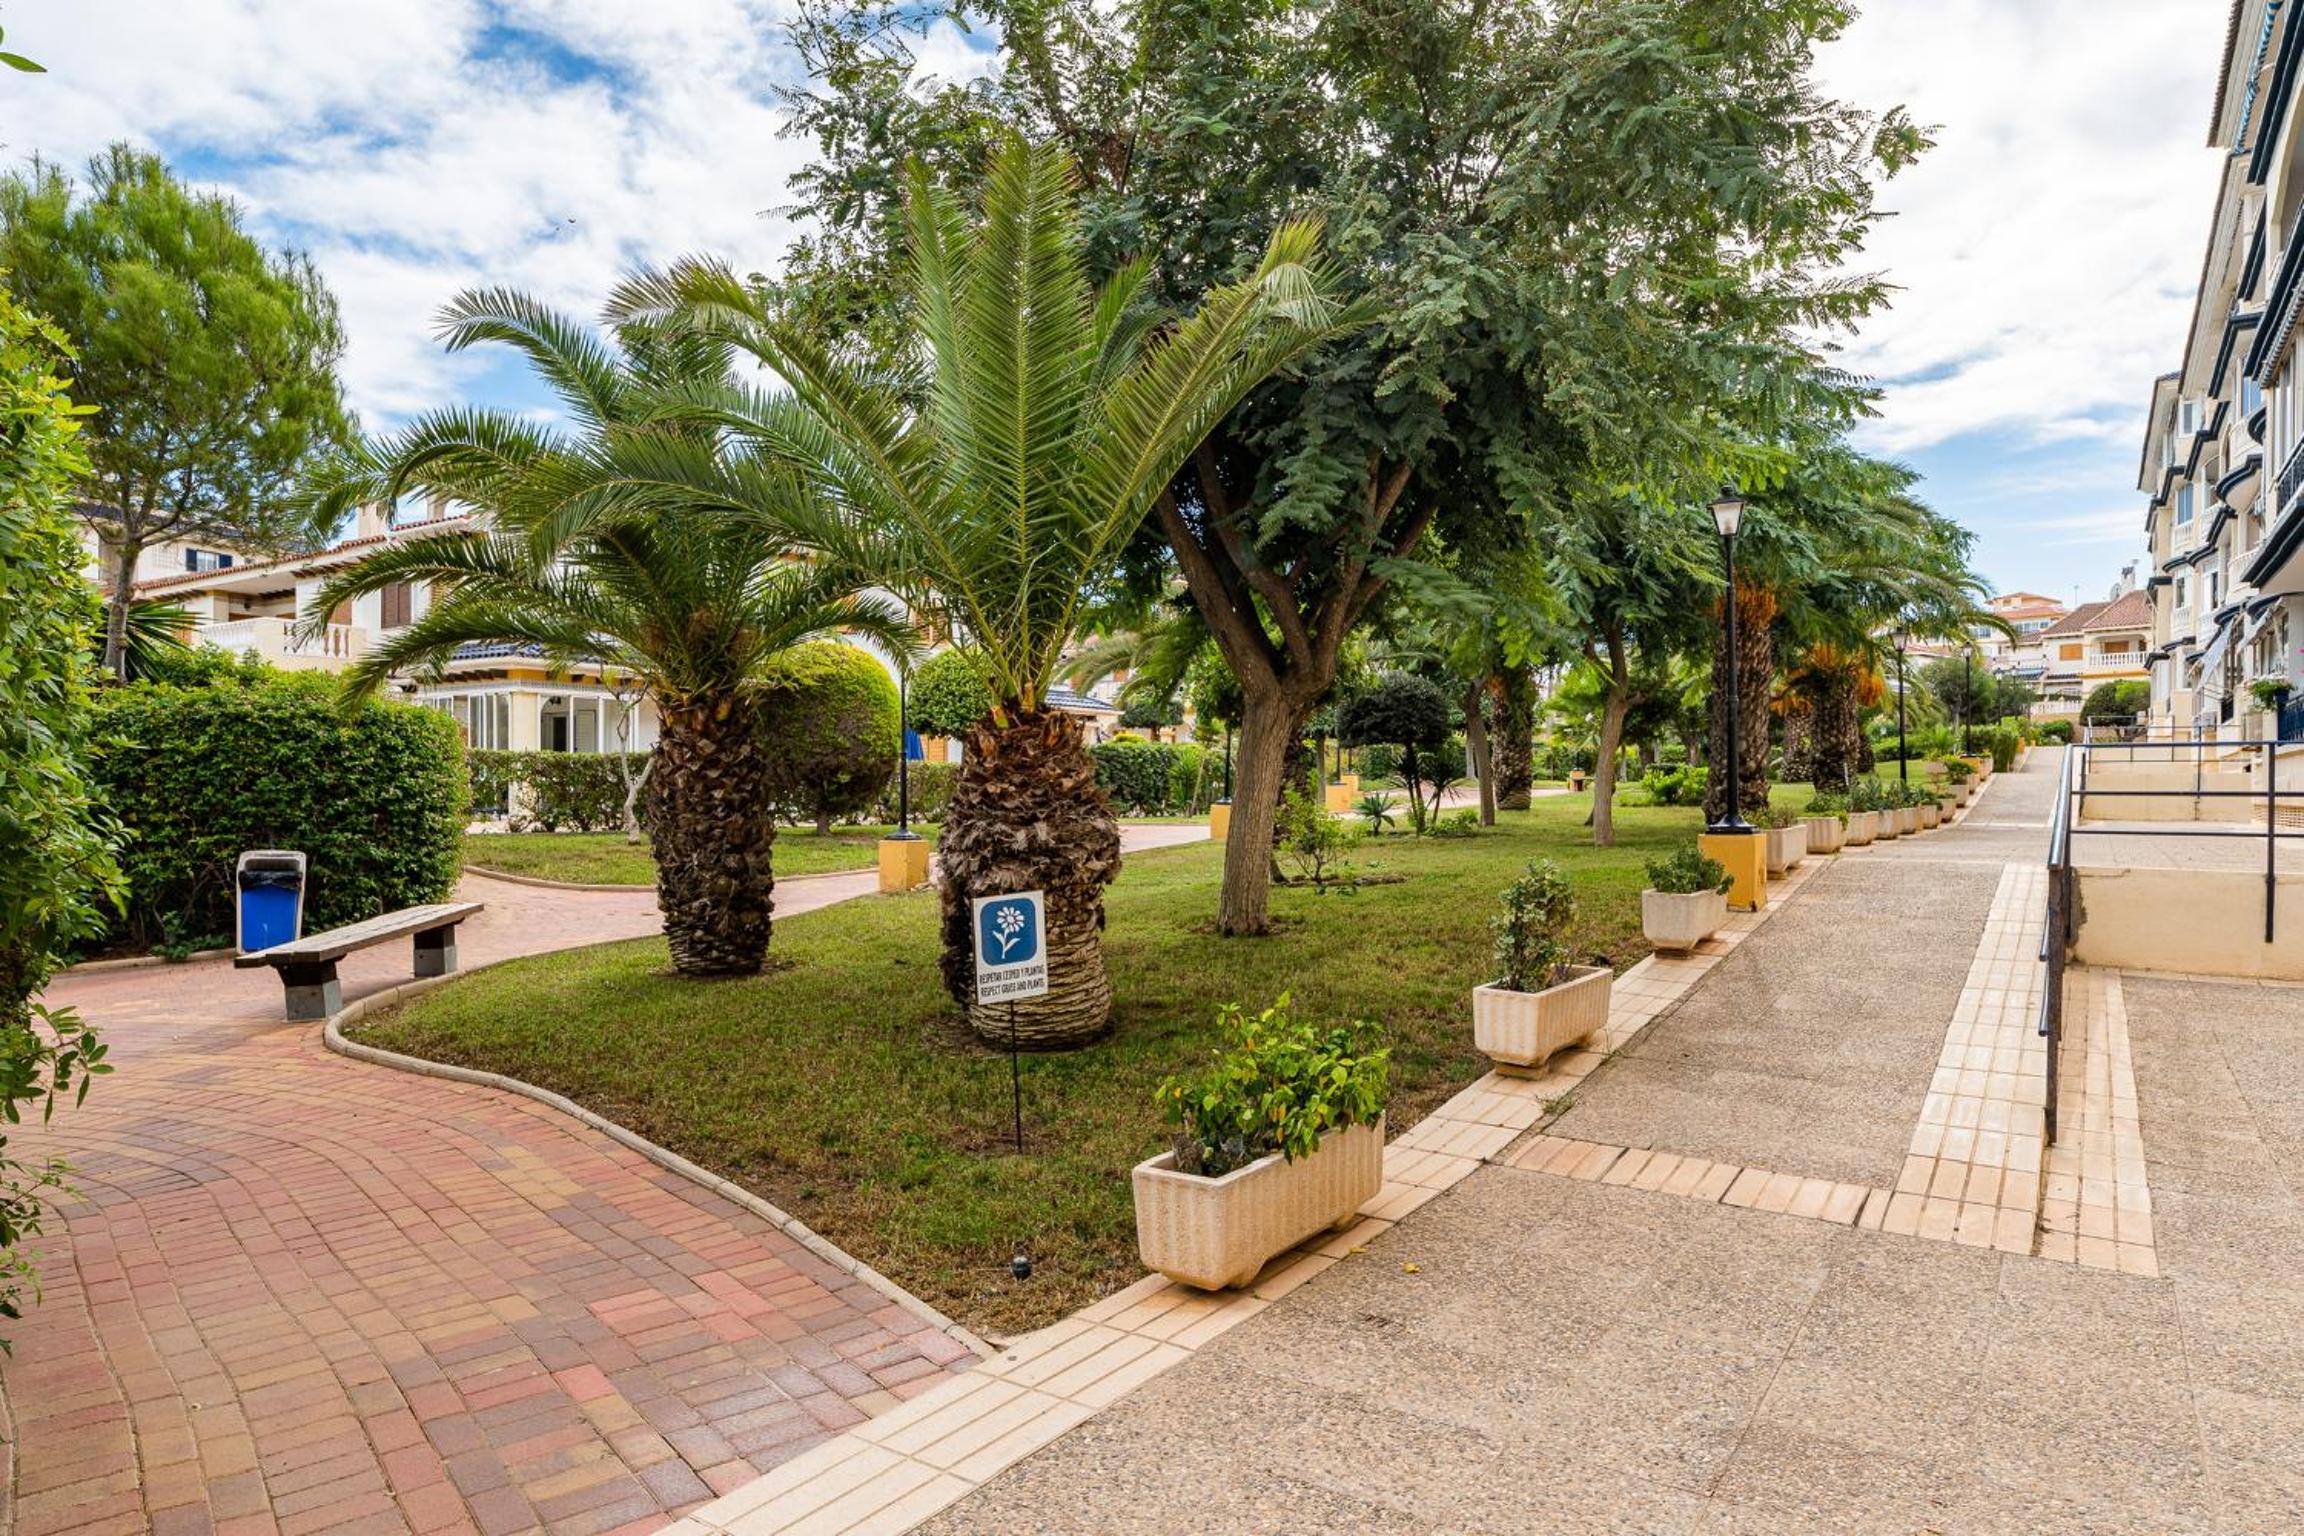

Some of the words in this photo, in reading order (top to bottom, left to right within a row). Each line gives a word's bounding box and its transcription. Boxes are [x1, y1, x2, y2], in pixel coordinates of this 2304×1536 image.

[980, 972, 1001, 985] RESPETAR
[1024, 965, 1044, 977] PLANTAS
[981, 985, 1001, 997] RESPECT
[1017, 980, 1027, 991] AND
[1027, 977, 1044, 989] PLANTS
